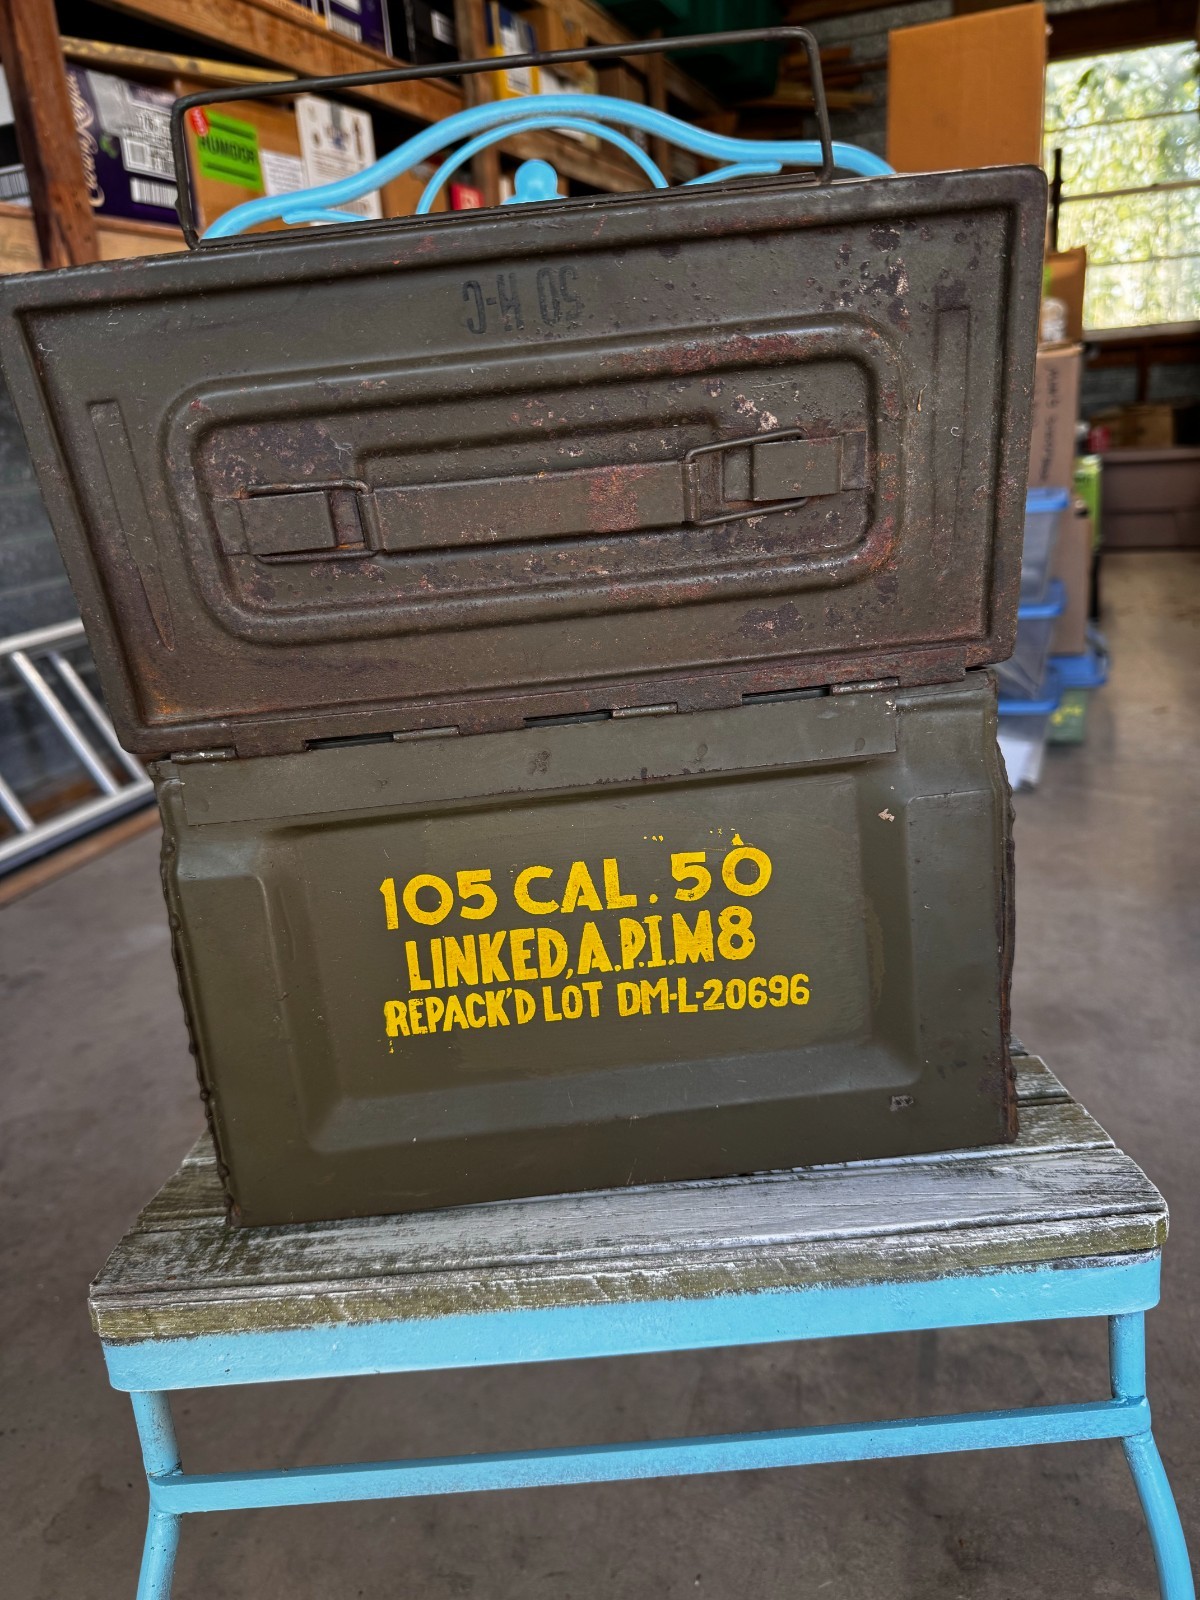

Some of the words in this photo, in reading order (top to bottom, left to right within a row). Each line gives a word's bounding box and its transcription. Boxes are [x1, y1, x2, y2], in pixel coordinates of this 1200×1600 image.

[379, 869, 497, 930] 105
[384, 988, 536, 1037] REPACK'D
[542, 981, 602, 1024] LOT
[617, 973, 809, 1019] DM-L-20696
